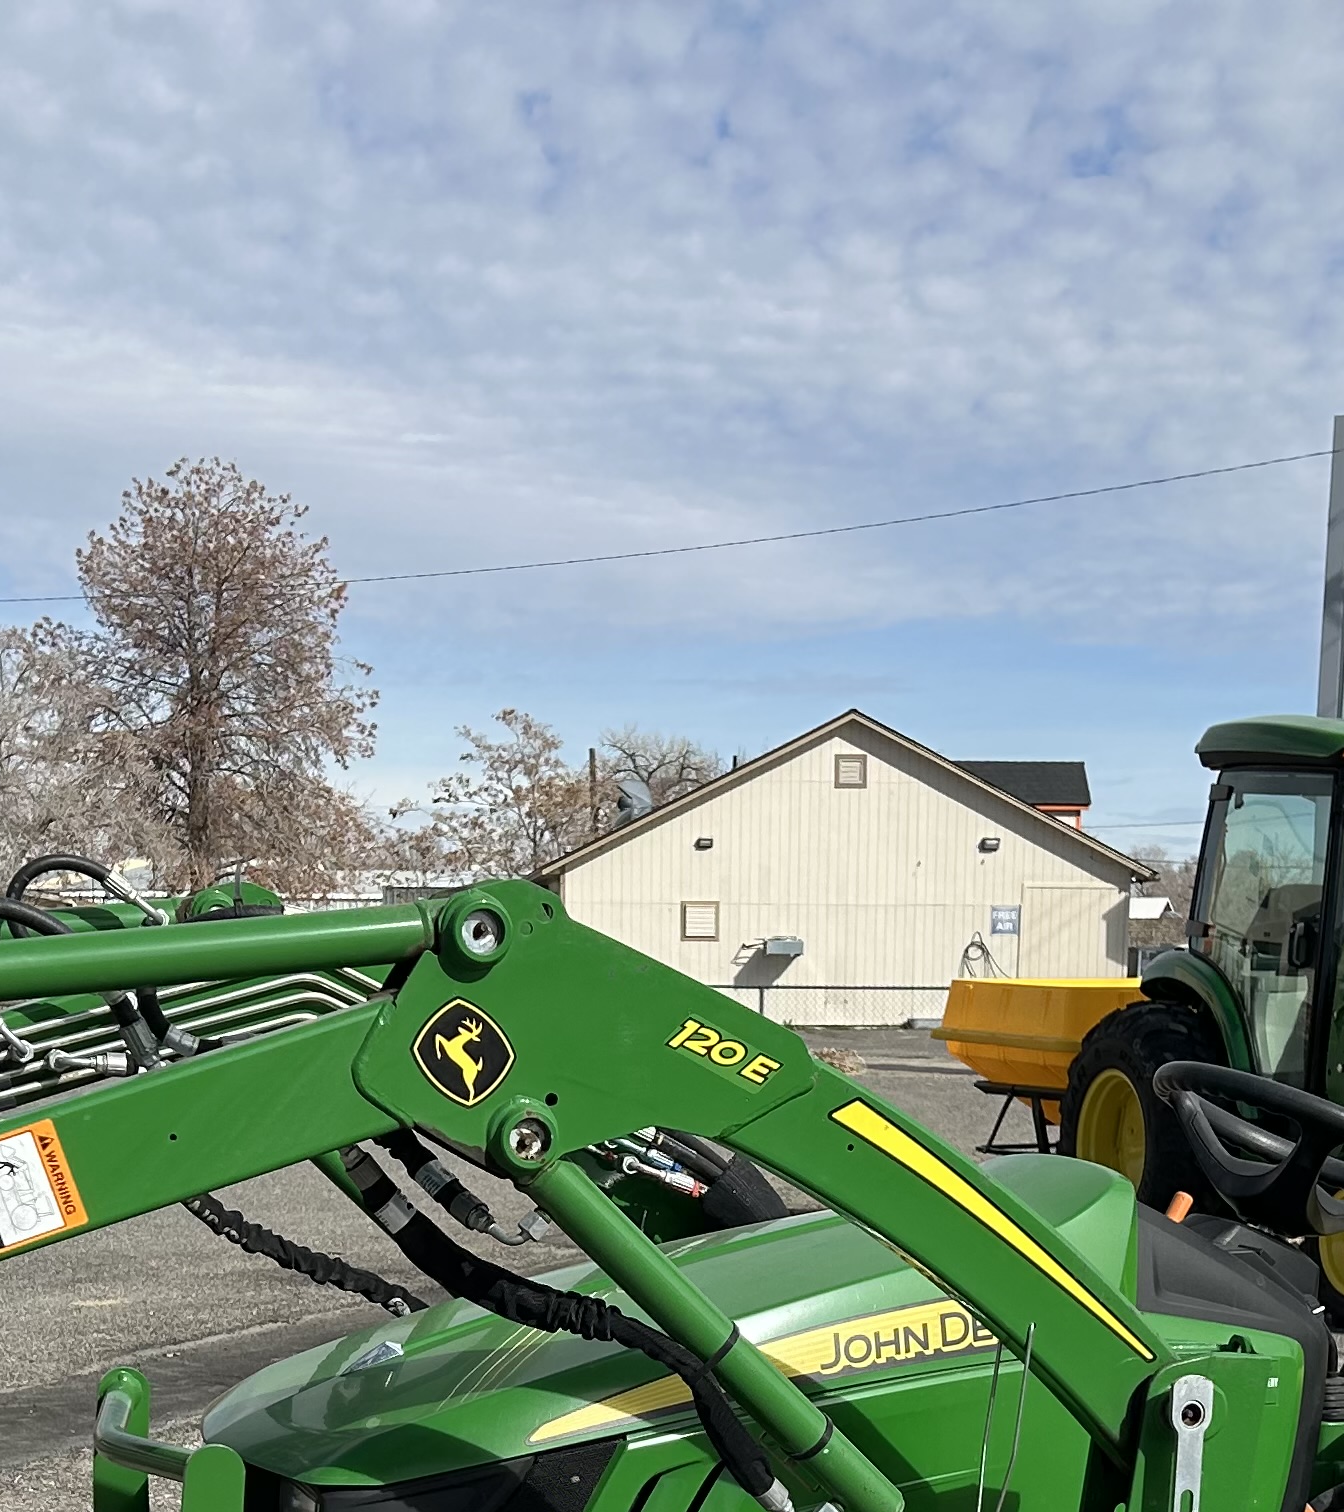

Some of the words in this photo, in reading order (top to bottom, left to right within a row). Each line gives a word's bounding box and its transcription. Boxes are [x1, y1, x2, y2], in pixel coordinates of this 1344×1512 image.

[992, 910, 1017, 920] FREE
[996, 921, 1014, 931] AIR
[665, 1017, 748, 1067] 120
[736, 1052, 784, 1086] E
[43, 1149, 77, 1216] WARNING
[820, 1322, 931, 1371] JOHN
